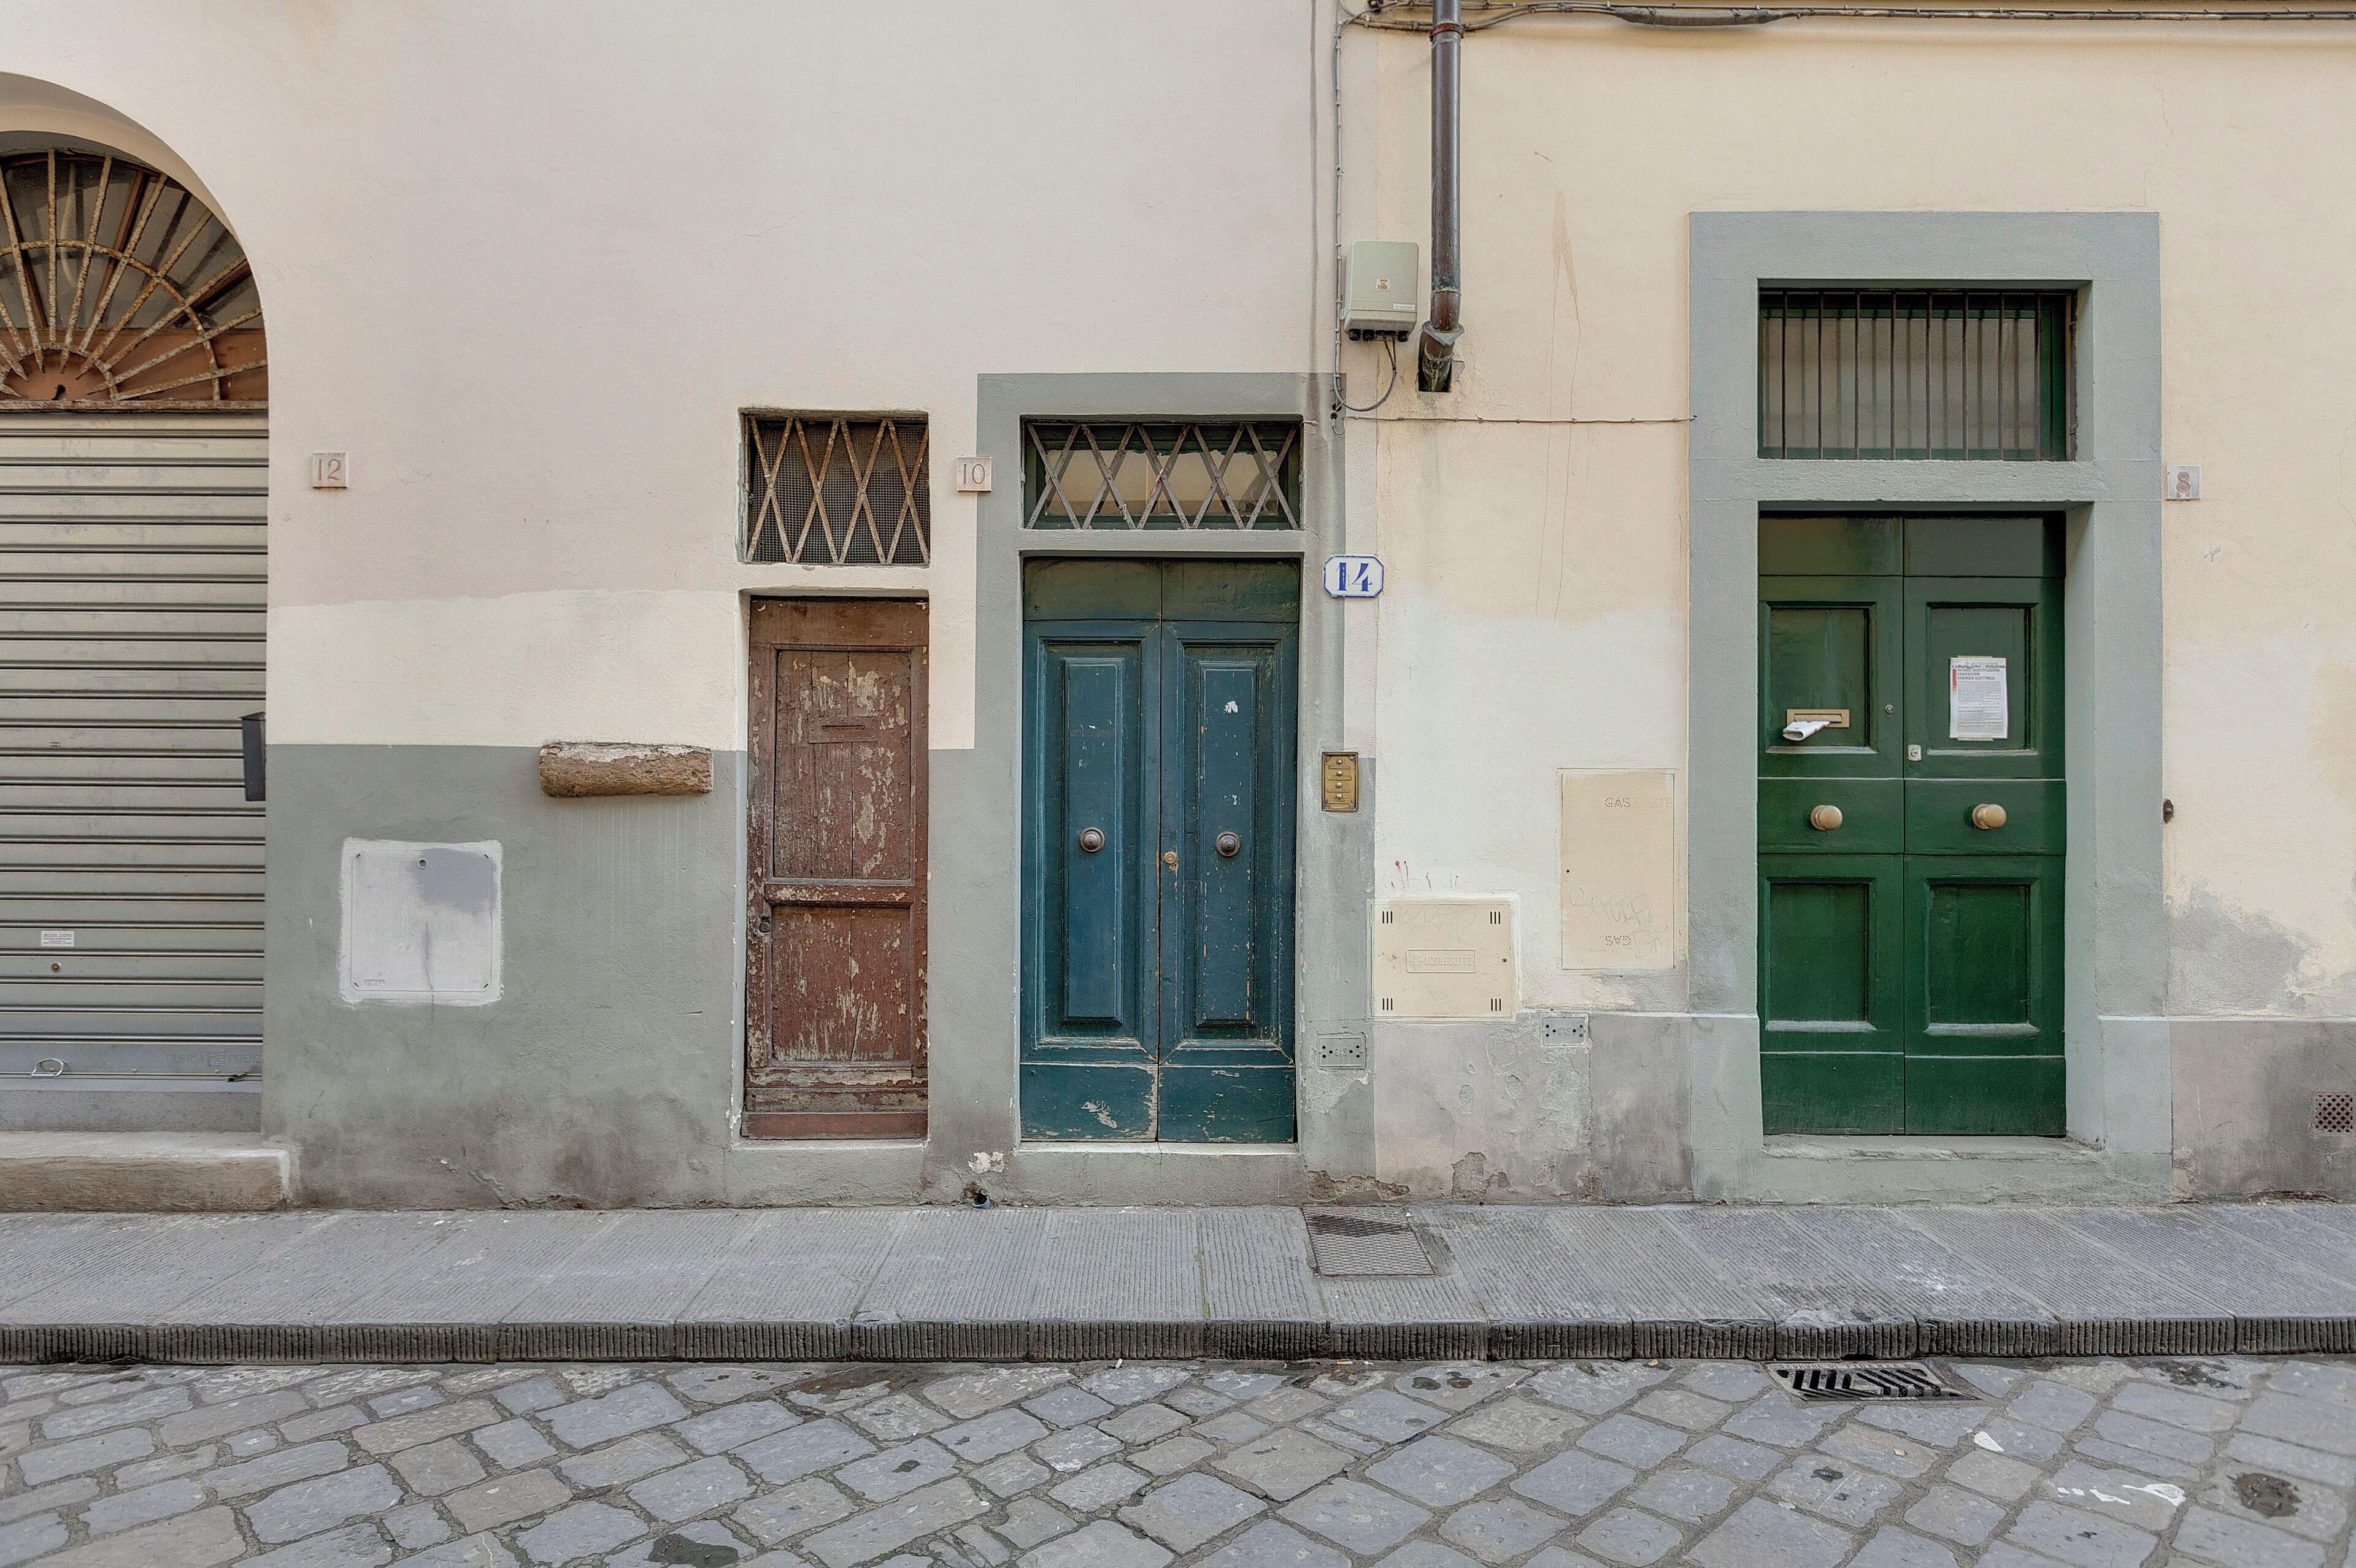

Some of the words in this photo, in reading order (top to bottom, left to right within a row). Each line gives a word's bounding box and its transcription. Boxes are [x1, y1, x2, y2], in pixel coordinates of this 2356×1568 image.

[318, 459, 341, 481] 12
[963, 463, 986, 485] 10
[2176, 471, 2191, 493] 8
[1336, 562, 1372, 592] 14
[1604, 796, 1631, 808] GAS
[1605, 935, 1631, 946] GAS
[1423, 956, 1472, 966] ACQUEDOTTO
[1556, 1026, 1571, 1036] GAS
[1334, 1047, 1348, 1057] GAS
[228, 1053, 262, 1064] FIRENZ
